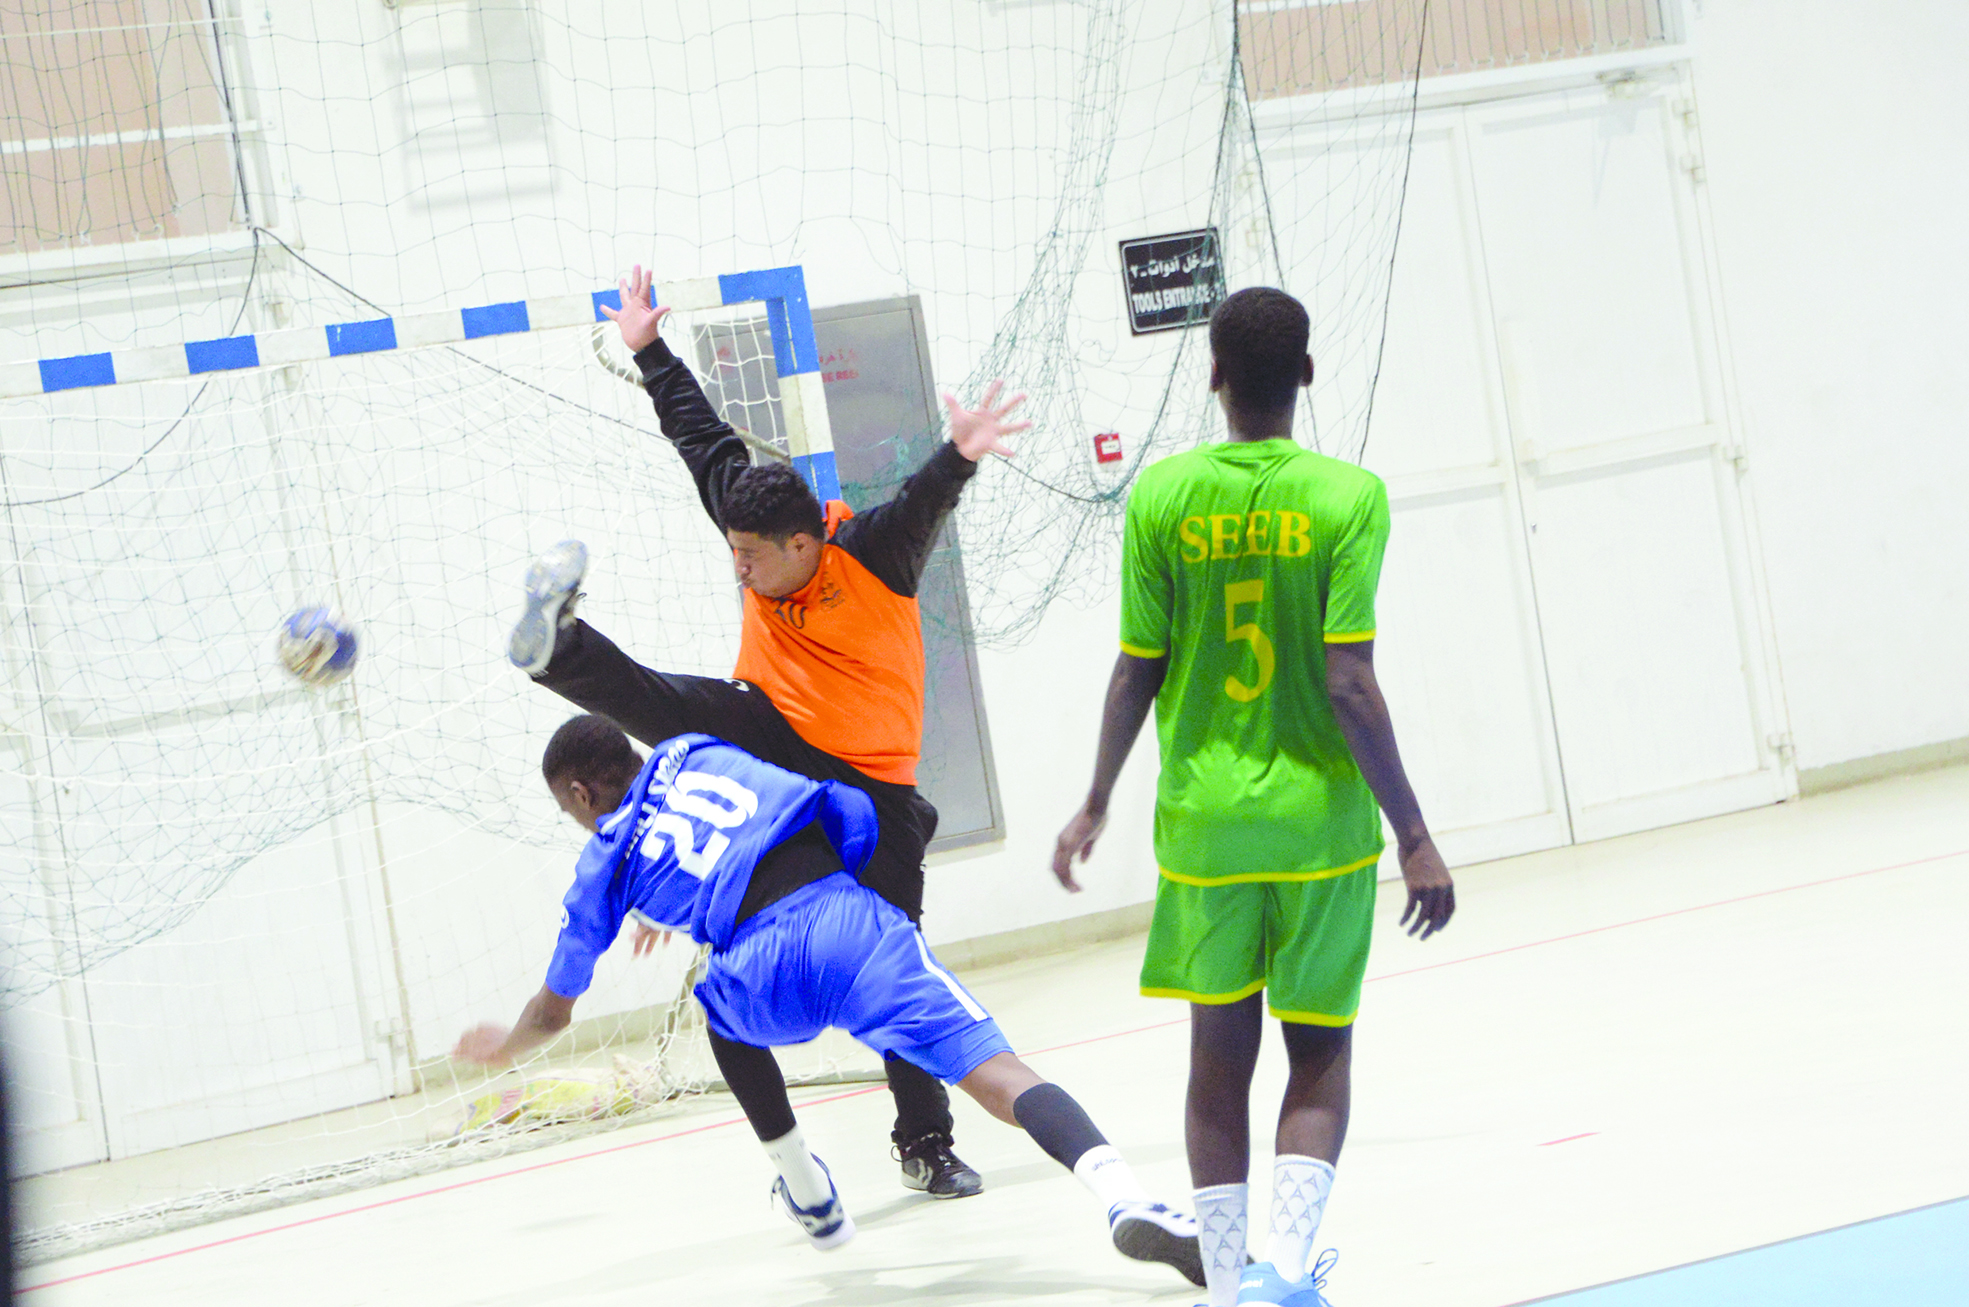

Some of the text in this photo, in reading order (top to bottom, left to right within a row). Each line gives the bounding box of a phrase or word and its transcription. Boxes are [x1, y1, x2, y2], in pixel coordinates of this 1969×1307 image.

[1132, 290, 1163, 314] TOOLS
[1179, 510, 1312, 563] SEEB
[1224, 579, 1276, 703] 5
[640, 771, 758, 881] 20
